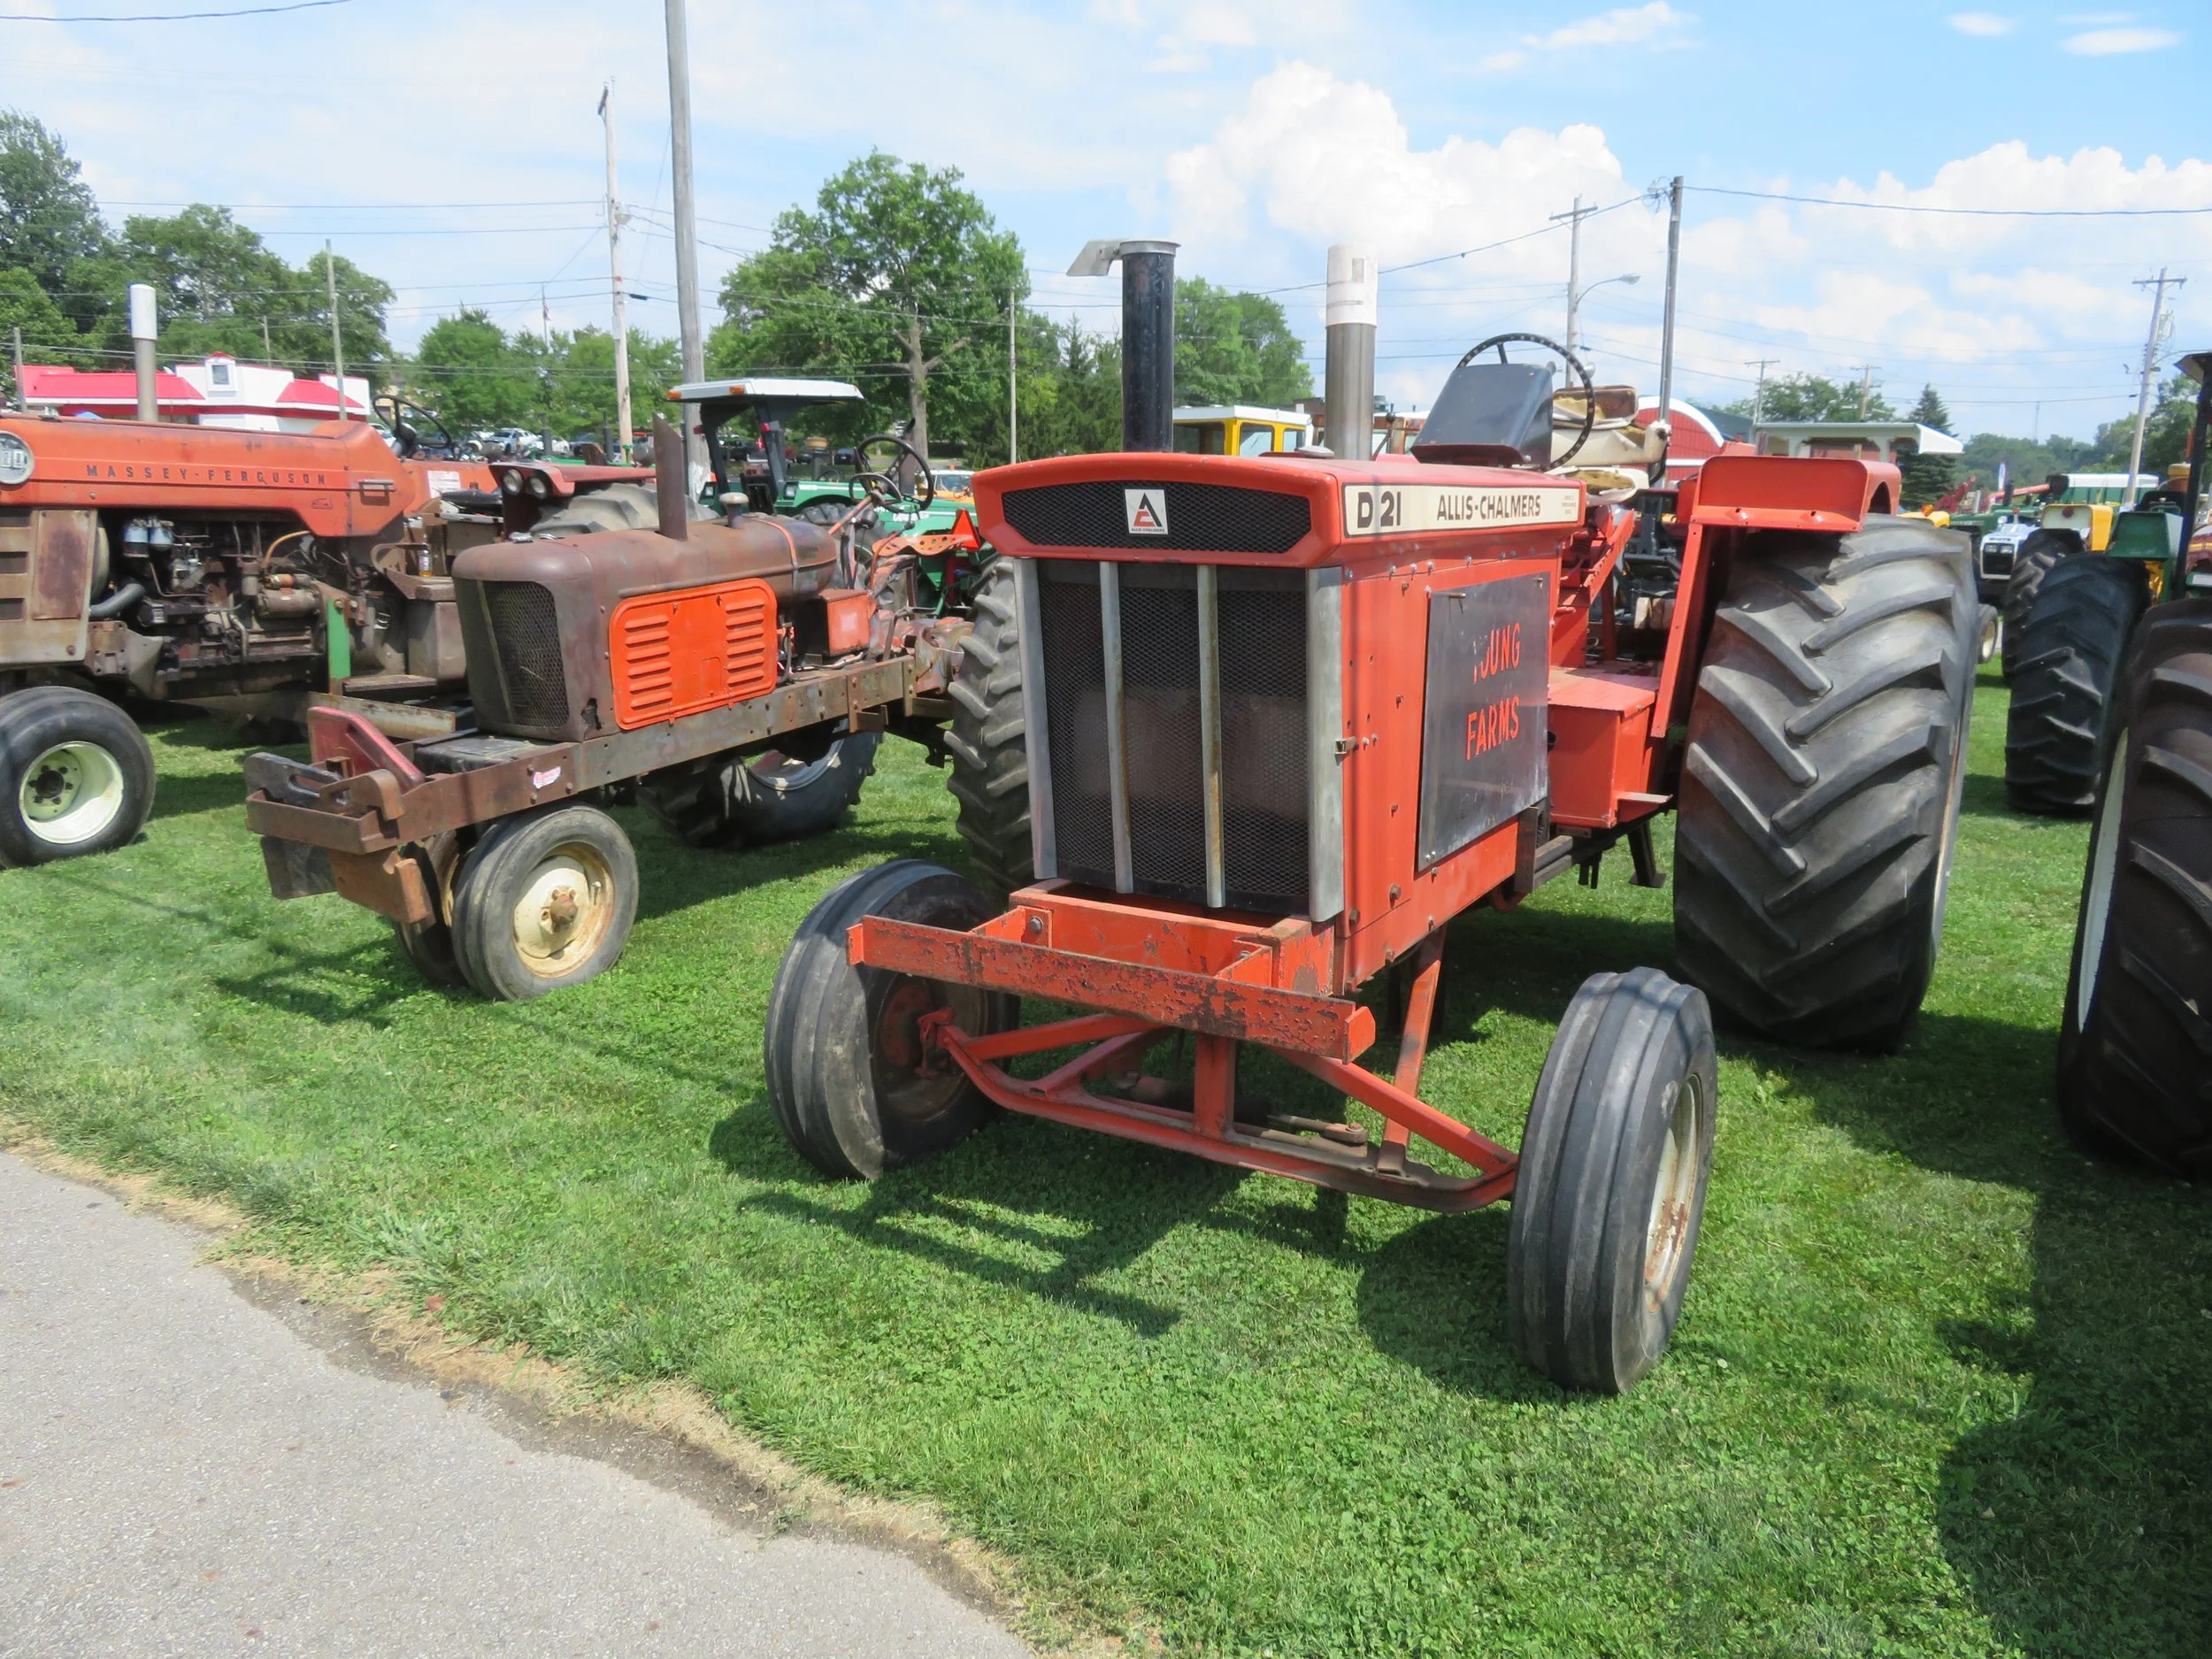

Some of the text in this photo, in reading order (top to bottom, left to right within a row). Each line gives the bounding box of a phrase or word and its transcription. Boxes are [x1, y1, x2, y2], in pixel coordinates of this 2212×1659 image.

[86, 465, 325, 485] MASSEY-FERGUSON
[1436, 494, 1541, 521] ALLIS-CHALMERS
[1465, 695, 1521, 761] FARMS
